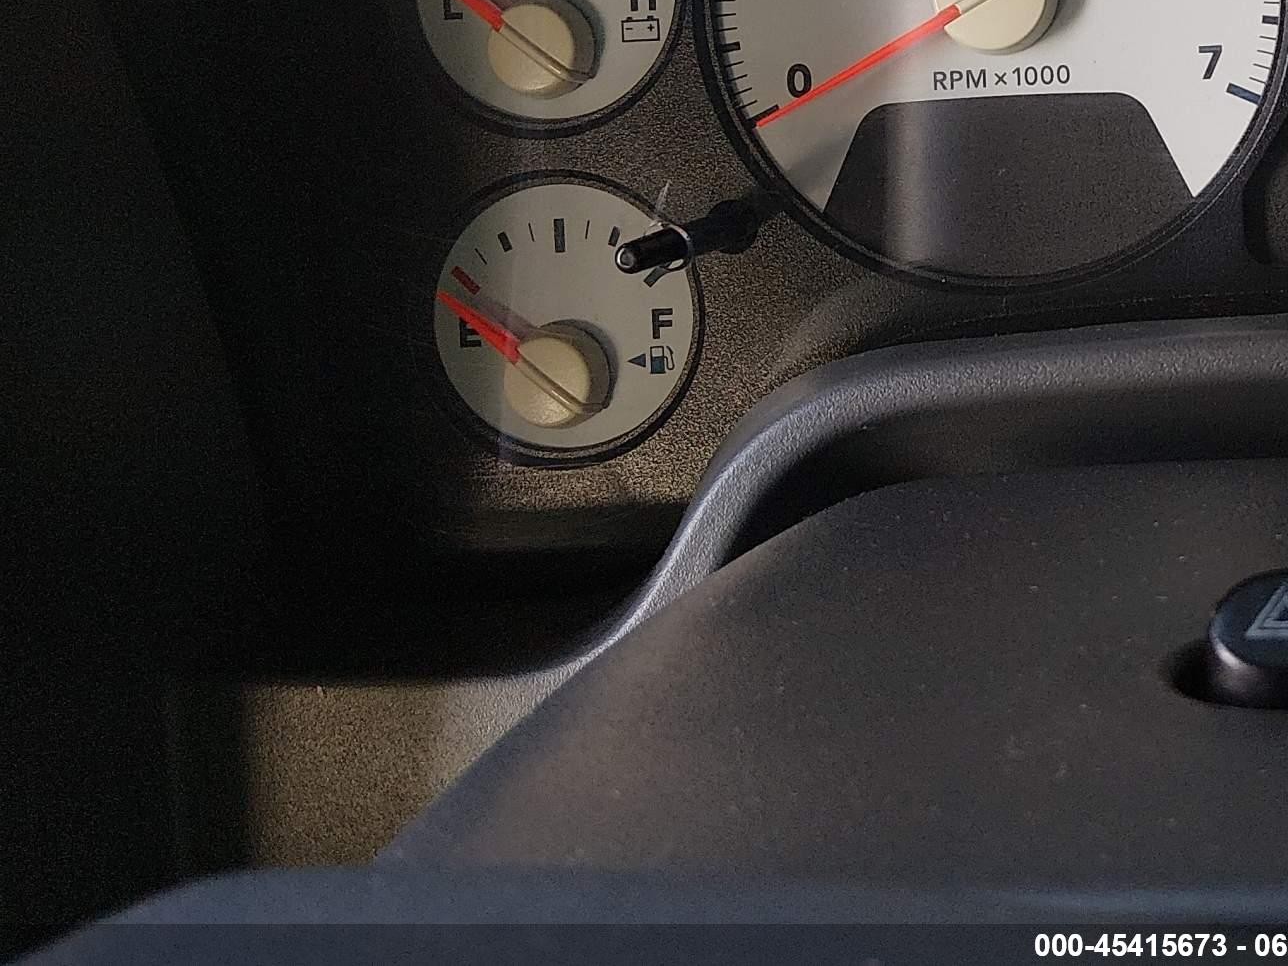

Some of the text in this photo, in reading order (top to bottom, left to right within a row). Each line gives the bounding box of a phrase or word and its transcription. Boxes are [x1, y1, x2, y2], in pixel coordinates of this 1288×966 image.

[1198, 44, 1224, 80] 7
[786, 63, 813, 97] 0
[932, 70, 987, 90] RPM
[651, 308, 674, 339] F
